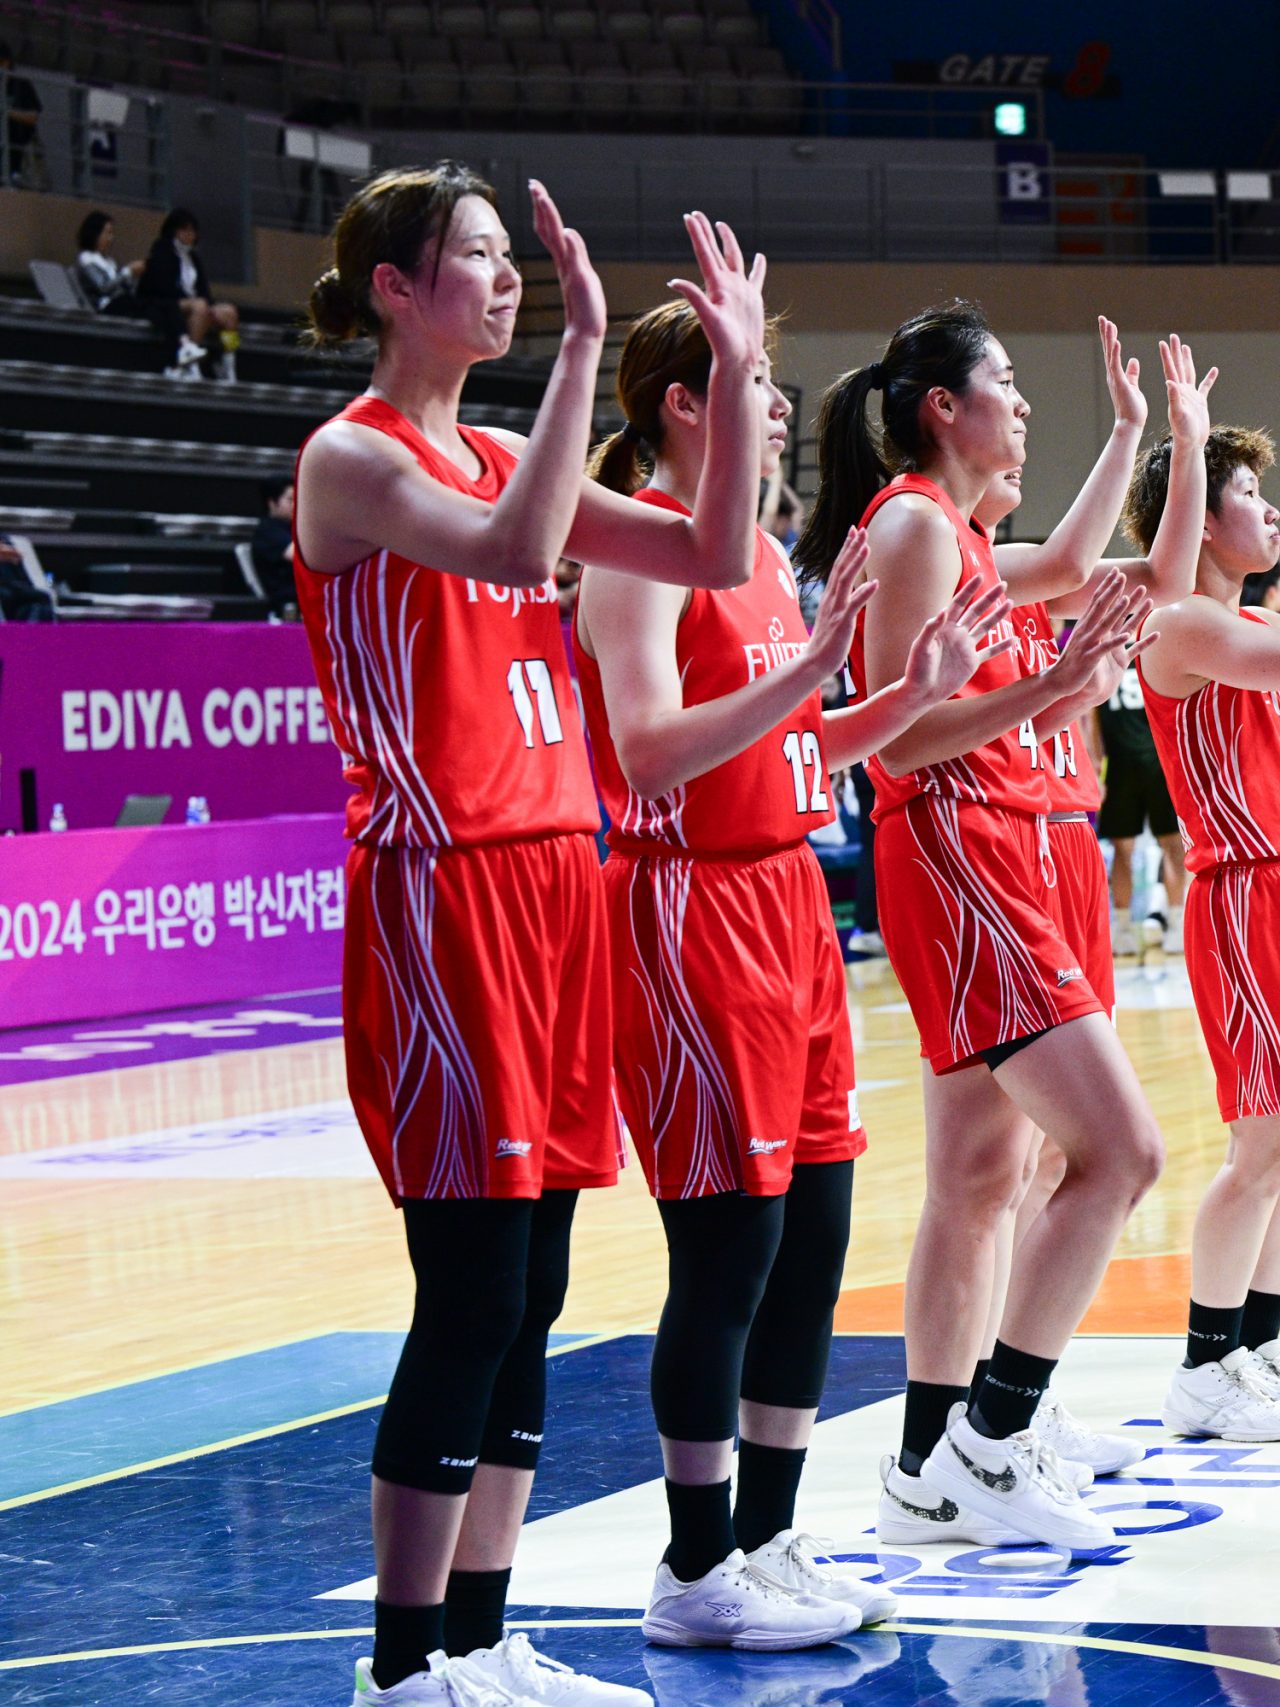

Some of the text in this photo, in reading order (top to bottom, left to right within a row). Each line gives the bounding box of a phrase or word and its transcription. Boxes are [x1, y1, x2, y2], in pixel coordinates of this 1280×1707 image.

[938, 41, 1111, 96] GATE 8
[1007, 162, 1042, 200] B
[62, 687, 331, 751] EDIYA COFFE
[506, 658, 564, 749] 11
[782, 730, 829, 814] 12
[0, 865, 345, 961] 2024 우리은행 박신자컵
